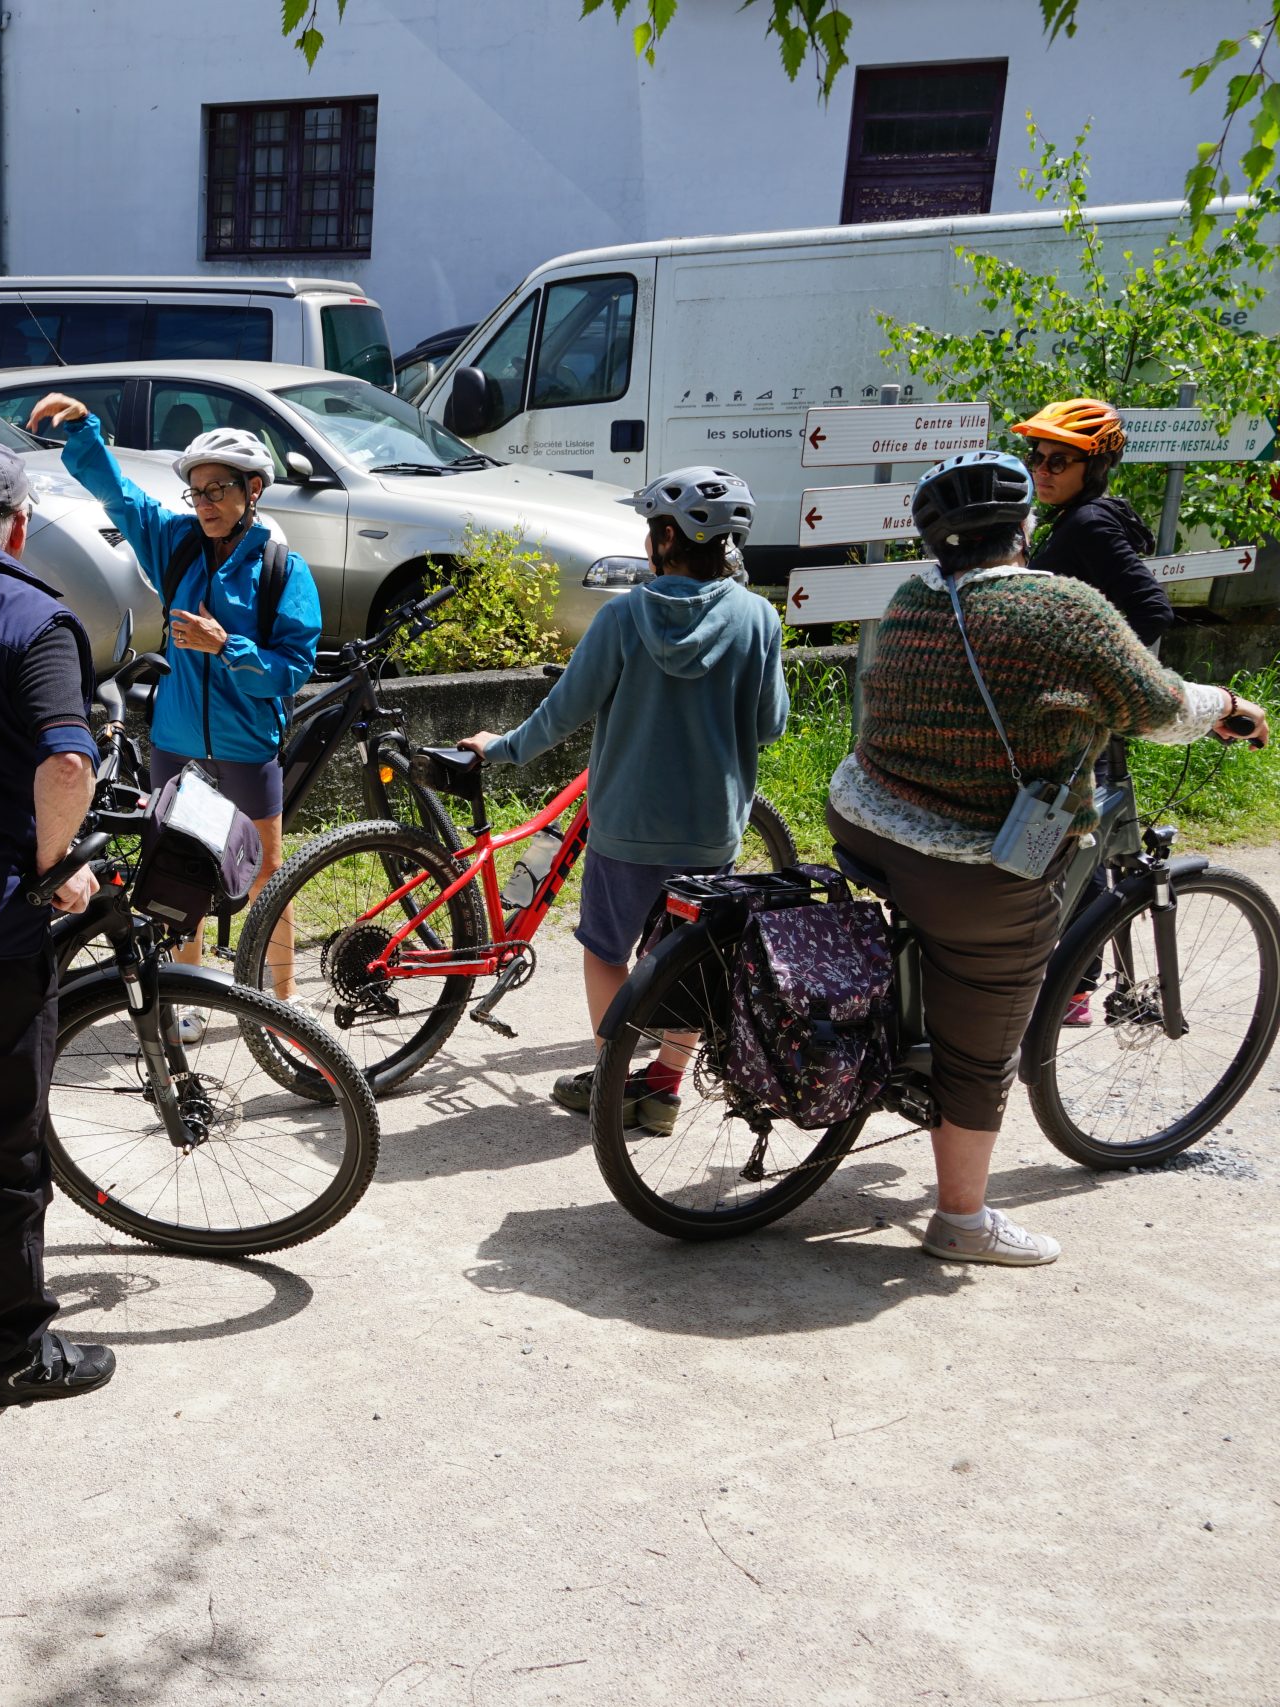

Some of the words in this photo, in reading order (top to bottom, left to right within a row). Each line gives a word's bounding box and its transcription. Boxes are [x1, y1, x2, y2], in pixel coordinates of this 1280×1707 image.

[915, 417, 953, 430] Centre
[960, 415, 986, 428] Ville
[1124, 420, 1215, 432] RGELES-GAZOST
[1248, 419, 1259, 431] 13
[707, 428, 725, 440] les
[732, 427, 793, 439] solutions
[508, 444, 529, 455] SLC
[872, 440, 908, 453] Office
[915, 439, 927, 451] de
[934, 437, 985, 450] tourisme
[1125, 439, 1230, 453] ERREFITTE-NESTALAS
[1244, 439, 1256, 450] 18
[534, 448, 543, 456] de
[546, 448, 595, 456] Construction
[882, 515, 915, 529] Musé
[1162, 564, 1185, 576] Cols
